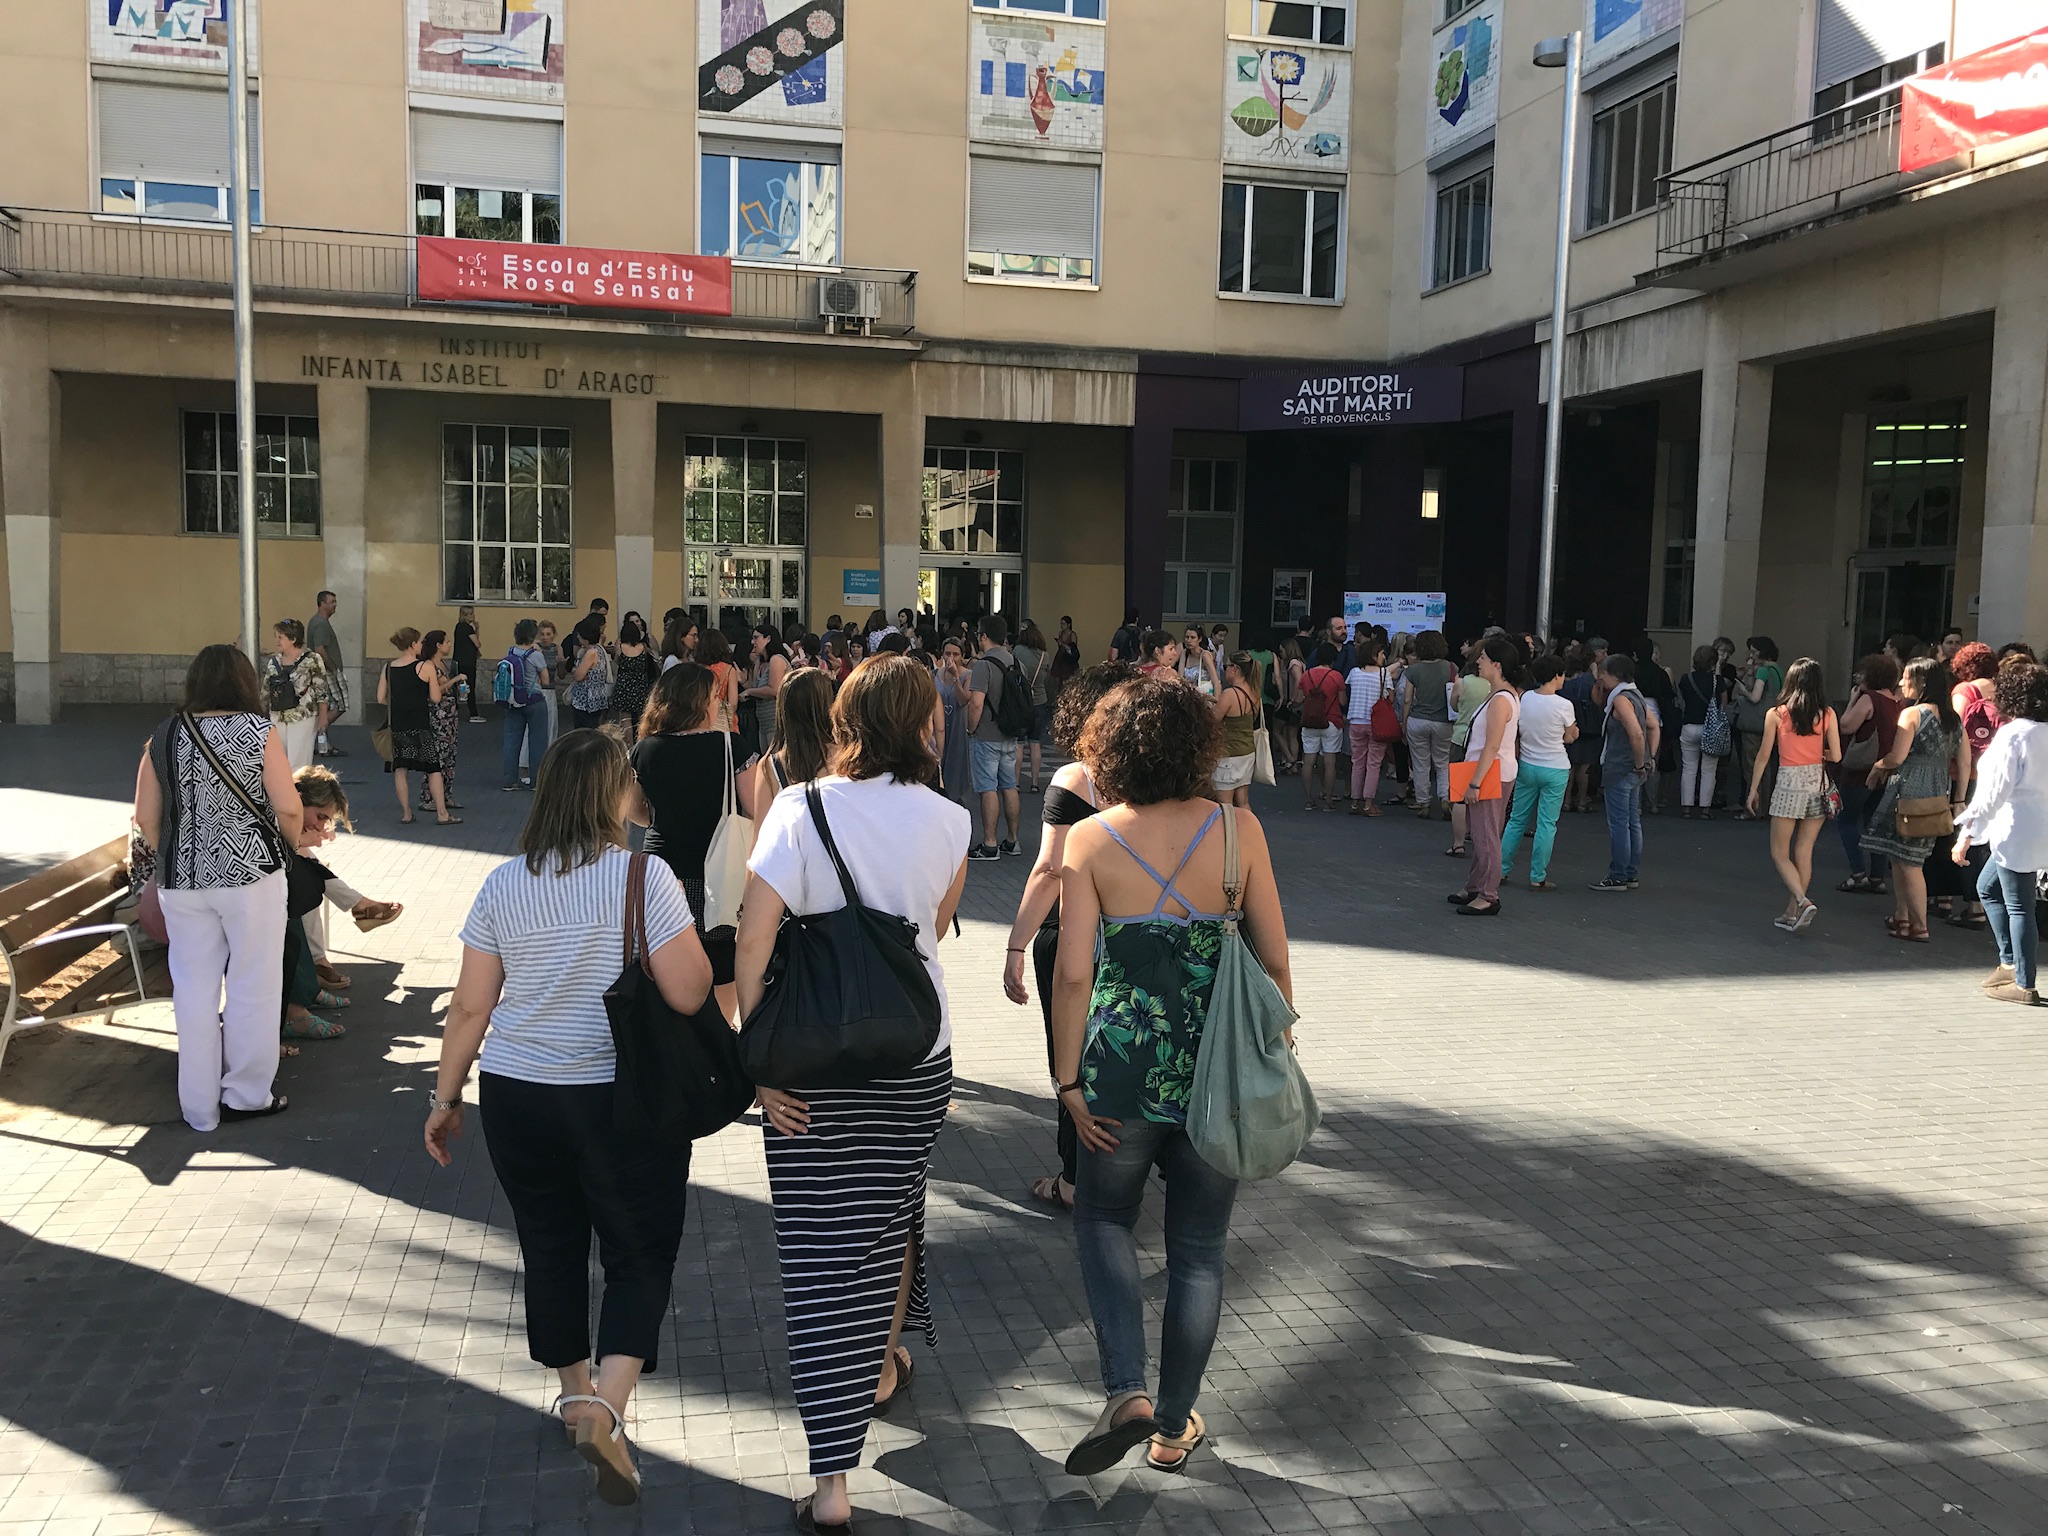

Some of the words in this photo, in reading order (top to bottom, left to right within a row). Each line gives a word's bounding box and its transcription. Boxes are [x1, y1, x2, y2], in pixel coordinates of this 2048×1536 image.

[458, 267, 487, 276] SEN
[503, 254, 589, 276] Escola
[600, 260, 694, 283] d'Estiu
[458, 279, 487, 288] SAT
[503, 273, 575, 293] Rosa
[594, 278, 695, 302] Sensat
[439, 337, 543, 361] INSTITUT
[301, 355, 403, 382] INFANTA
[422, 362, 509, 388] ISABEL
[544, 367, 566, 390] D'
[1297, 374, 1400, 398] AUDITORI
[1282, 396, 1340, 417] SANT
[1343, 387, 1414, 413] MARTÍ
[1303, 416, 1317, 425] DE
[1320, 412, 1392, 425] PROVENÇALS
